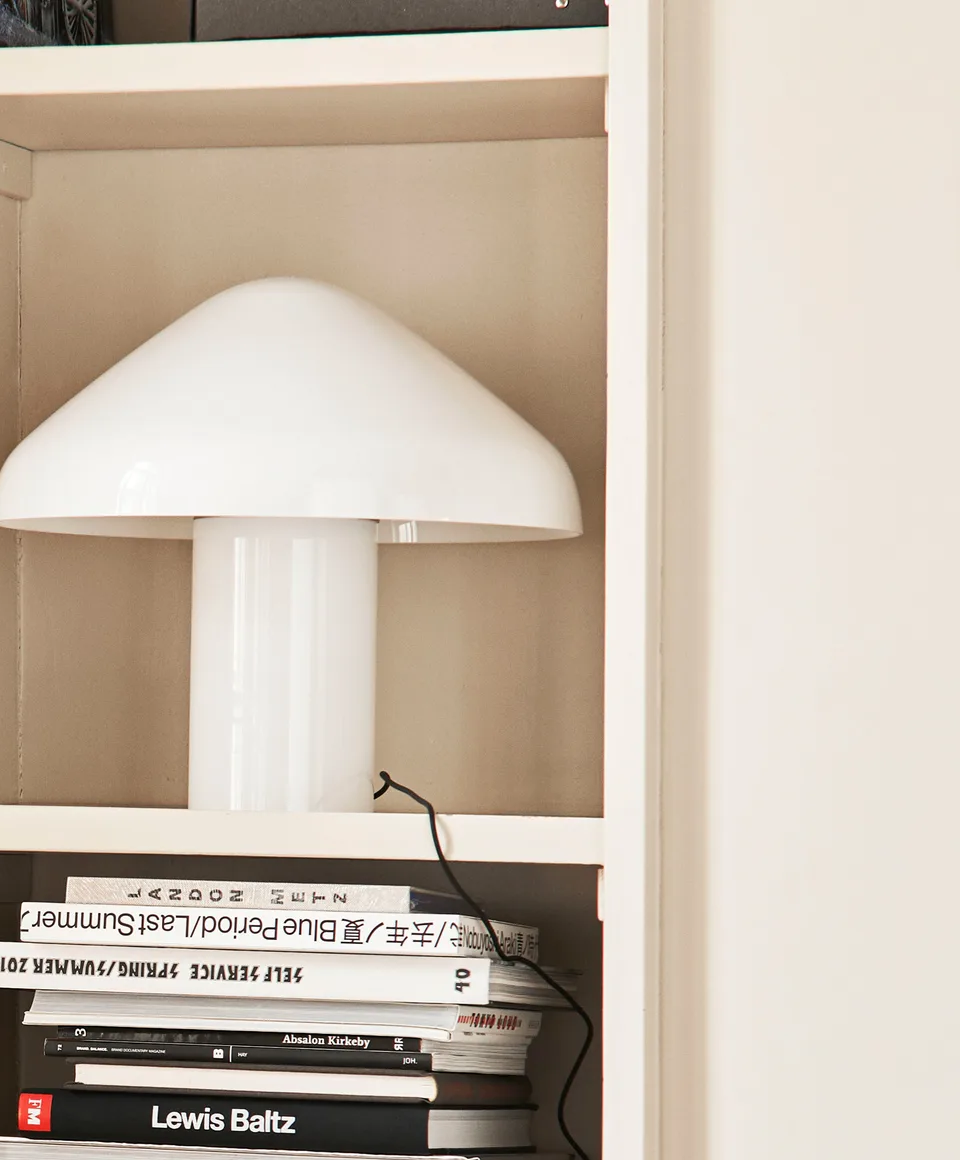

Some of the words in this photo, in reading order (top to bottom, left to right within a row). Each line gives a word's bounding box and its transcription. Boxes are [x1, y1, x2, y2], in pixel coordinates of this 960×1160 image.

[32, 957, 180, 980] SPRING/SUMMER
[190, 964, 261, 982] SERVICE
[263, 966, 304, 983] SELF
[282, 1033, 325, 1046] Absalon
[328, 1035, 371, 1050] Kirkeby
[26, 1098, 43, 1126] FM
[151, 1105, 225, 1131] Lewis
[230, 1108, 296, 1134] Baltz
